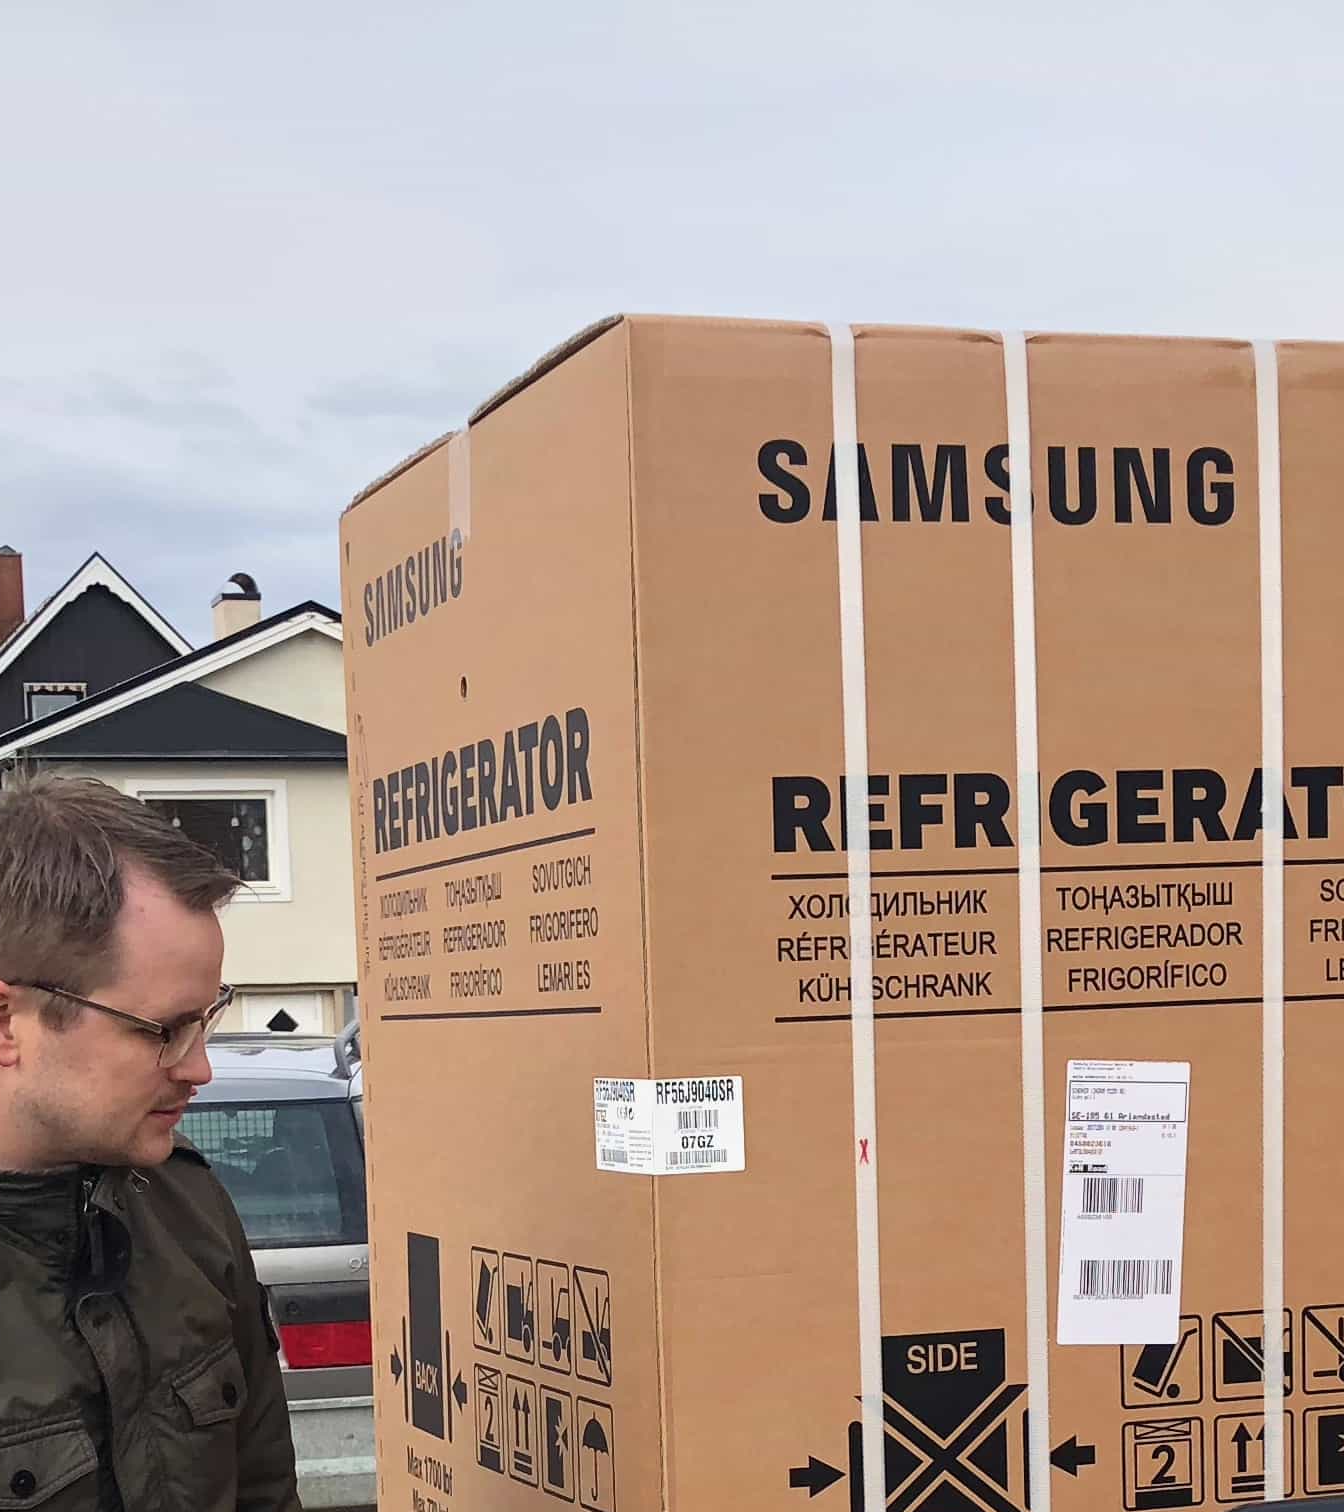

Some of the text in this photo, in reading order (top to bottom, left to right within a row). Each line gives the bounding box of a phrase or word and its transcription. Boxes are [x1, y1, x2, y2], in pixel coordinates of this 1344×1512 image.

[364, 527, 463, 648] SAMSUNG
[373, 707, 592, 854] REFRIGERATOR
[532, 855, 592, 894] SOVUTGICH
[788, 889, 988, 921] ХОЛДИЛЬНИК
[443, 919, 506, 954] REFRIGERADOR
[529, 906, 599, 944] FRIGORIFERO
[1047, 922, 1243, 952] REFRIGERADOR
[777, 929, 997, 962] RÉFRÉRATEUR
[450, 964, 503, 998] FRIGORÍFICO
[537, 959, 591, 993] LEMARI ES
[799, 972, 992, 1003] KÜHSCHRANK
[1068, 960, 1228, 992] FRIGORÍFICO
[656, 1079, 734, 1104] RF56J9040SR
[681, 1135, 714, 1149] 07GZ
[906, 1341, 978, 1374] SIDE
[416, 1360, 438, 1397] BACK
[484, 1396, 494, 1442] 2
[407, 1445, 423, 1480] Max
[424, 1456, 441, 1490] 1700
[1151, 1445, 1176, 1485] 2
